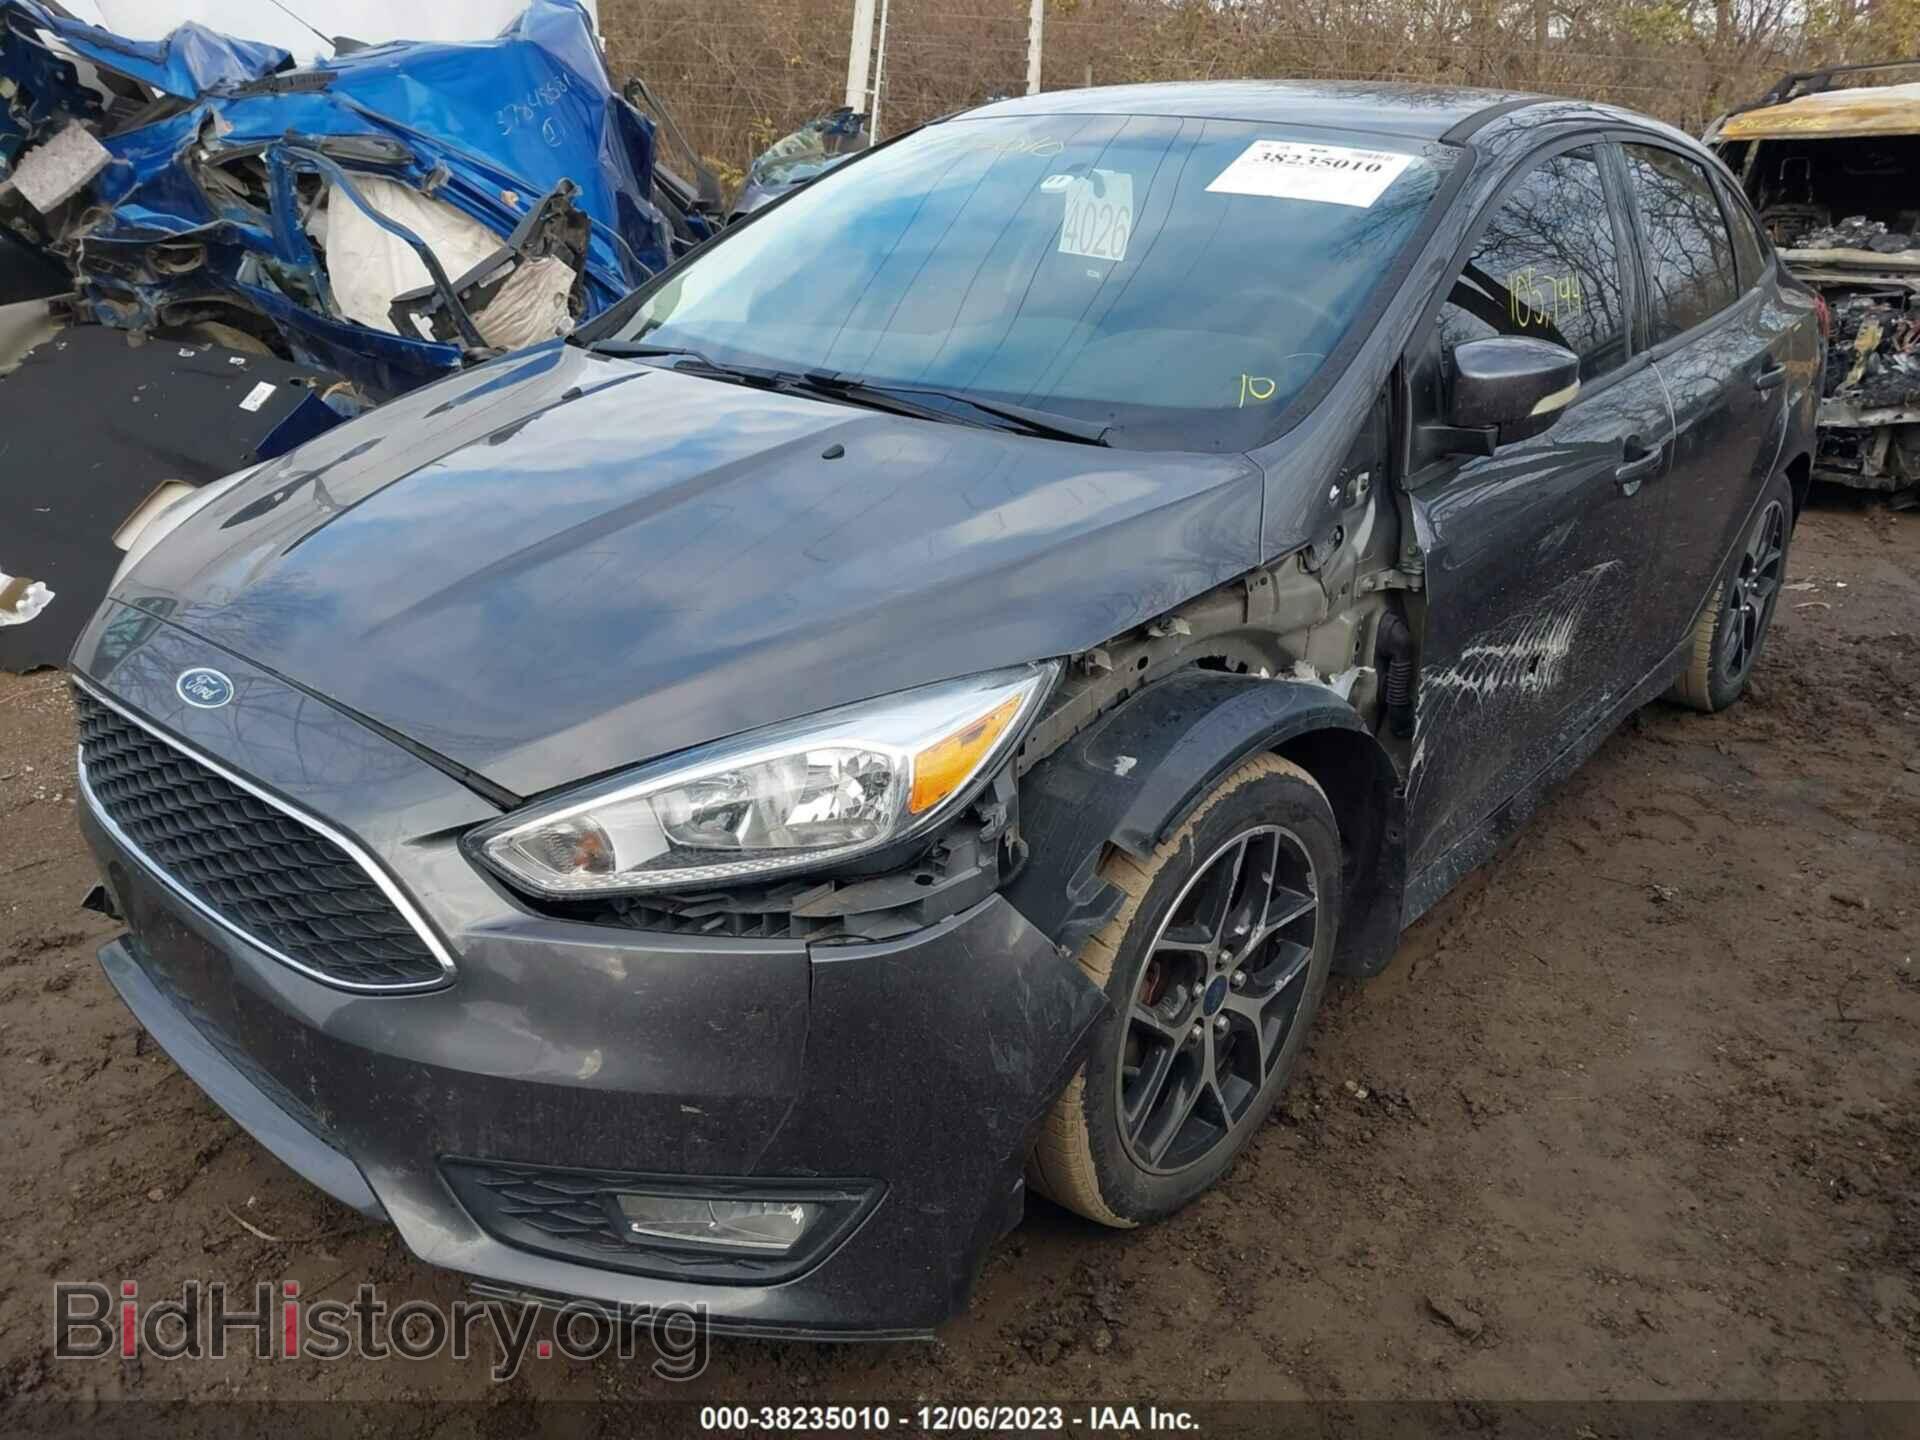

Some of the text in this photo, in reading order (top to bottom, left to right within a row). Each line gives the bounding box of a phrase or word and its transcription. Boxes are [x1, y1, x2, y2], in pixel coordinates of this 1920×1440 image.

[1253, 152, 1383, 173] 38235010
[1063, 199, 1130, 258] 4026
[1239, 373, 1275, 409] 10
